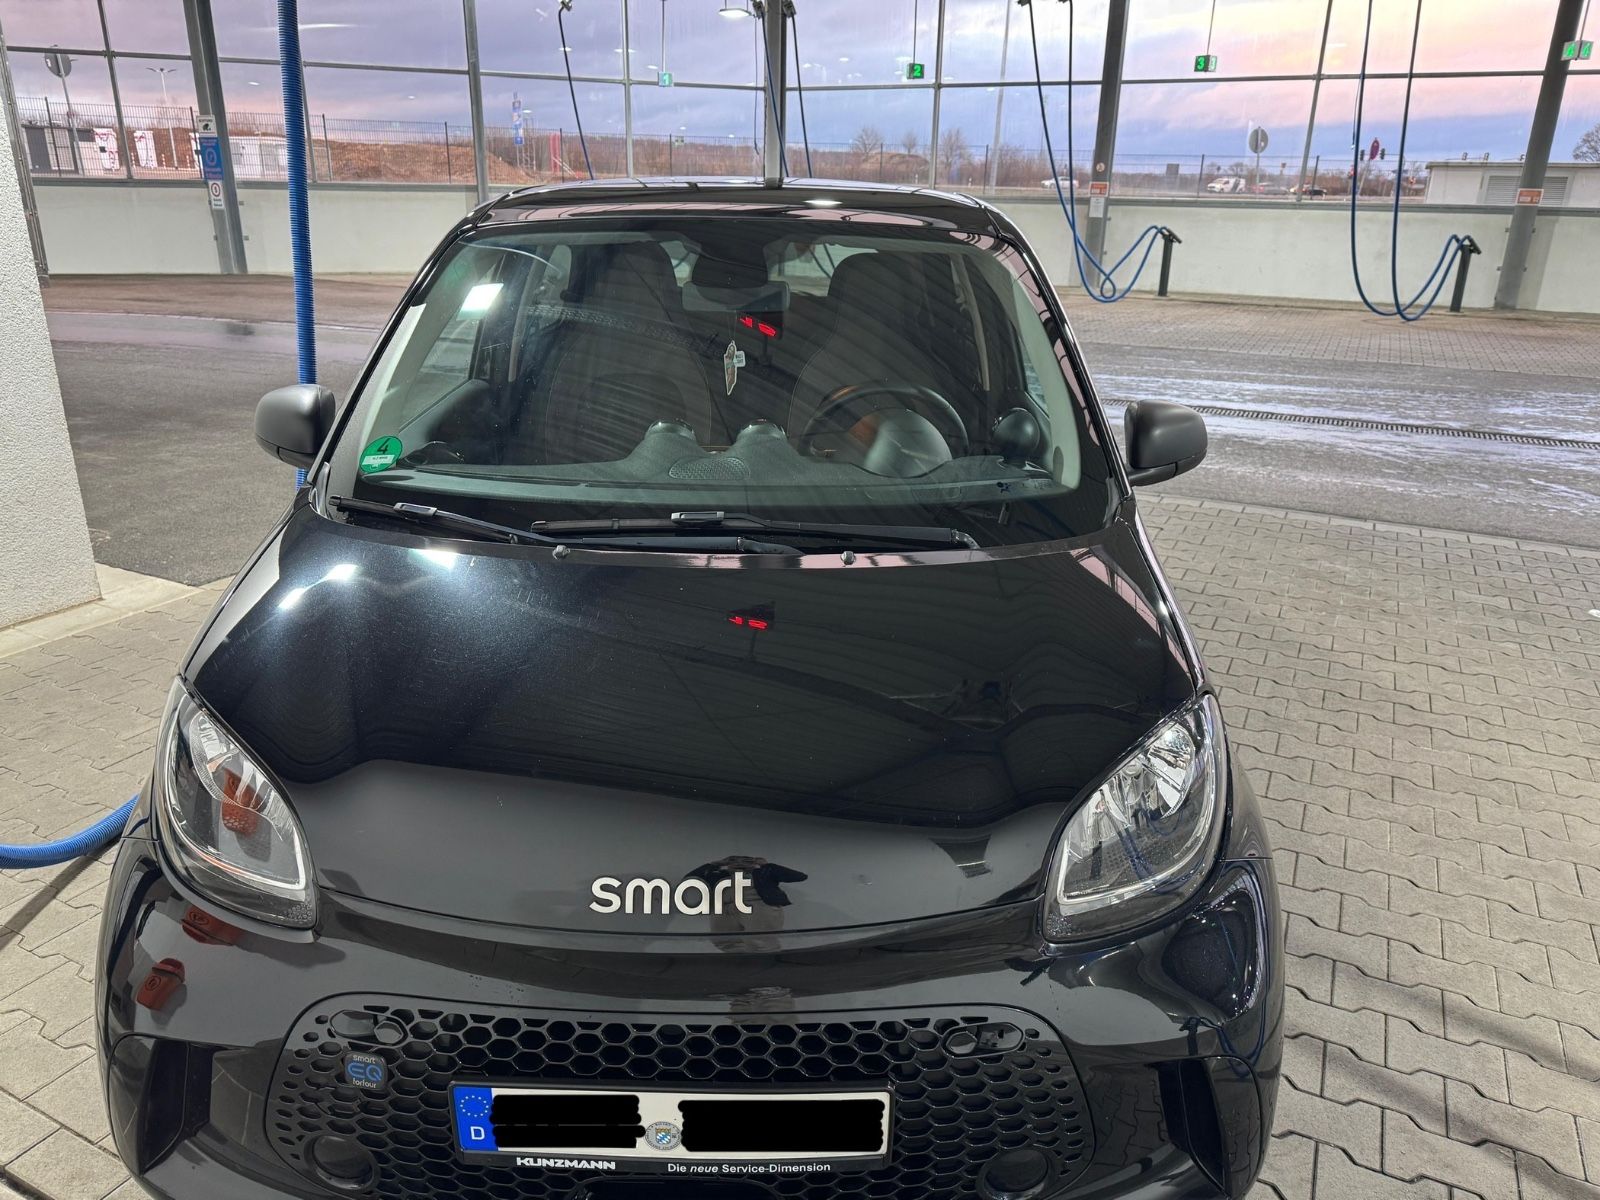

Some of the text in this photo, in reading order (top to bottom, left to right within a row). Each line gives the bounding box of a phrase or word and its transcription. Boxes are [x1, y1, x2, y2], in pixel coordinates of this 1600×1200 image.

[1197, 57, 1205, 69] 3
[913, 65, 921, 76] 2
[377, 438, 391, 454] 4
[589, 871, 752, 916] smart
[353, 1054, 376, 1064] smart
[348, 1062, 382, 1082] EQ
[352, 1077, 377, 1088] forfour
[470, 1126, 485, 1140] D
[516, 1157, 616, 1170] KUNZMANN
[667, 1162, 831, 1173] Die neue Service-Dimension
